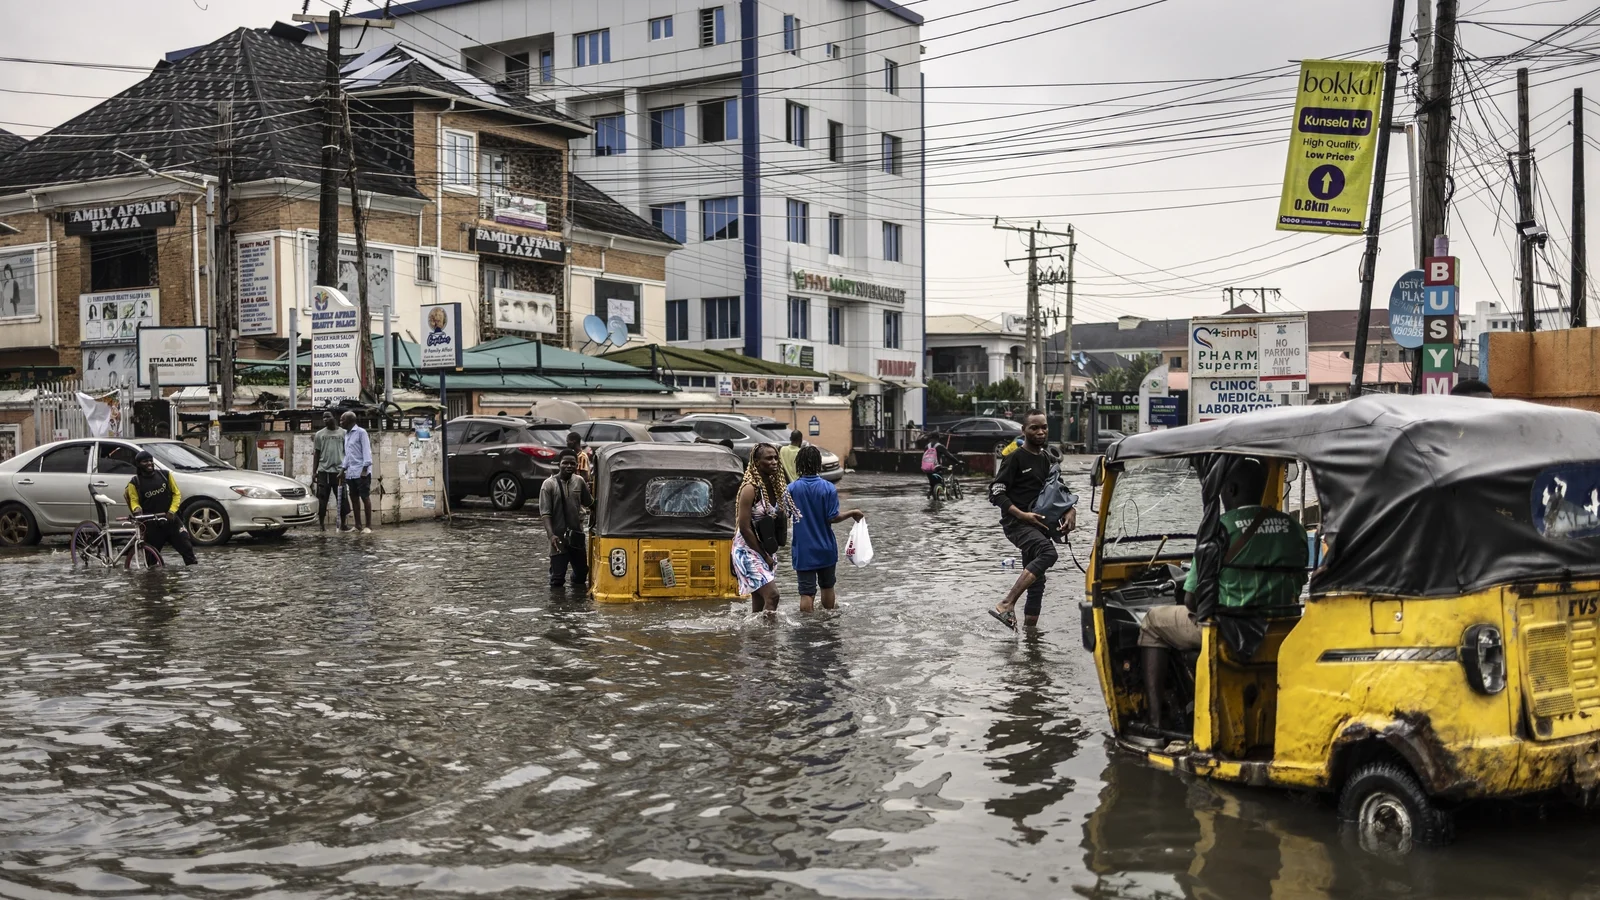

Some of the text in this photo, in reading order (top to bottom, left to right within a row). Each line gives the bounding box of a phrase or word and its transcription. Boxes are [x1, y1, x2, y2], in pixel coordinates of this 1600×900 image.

[1303, 70, 1379, 96] bokku!
[1304, 114, 1367, 129] Kunsela Rd
[1303, 138, 1361, 150] High Quality,
[1305, 151, 1354, 162] Low Prices
[117, 201, 166, 217] AFFAIR
[1294, 199, 1351, 214] 0.8km Away
[91, 217, 141, 232] PLAZA
[476, 229, 561, 251] FAMILY AFFAIR
[498, 243, 542, 258] PLAZA
[312, 310, 356, 320] FAMILY AFFAIR
[312, 320, 356, 329] BEAUTY PALACE
[1276, 339, 1288, 347] NO
[1264, 348, 1300, 357] PARKING
[877, 359, 916, 377] PHARMACY
[1272, 358, 1290, 366] ANY
[1218, 393, 1273, 402] MEDICAL
[145, 486, 165, 498] Glovo
